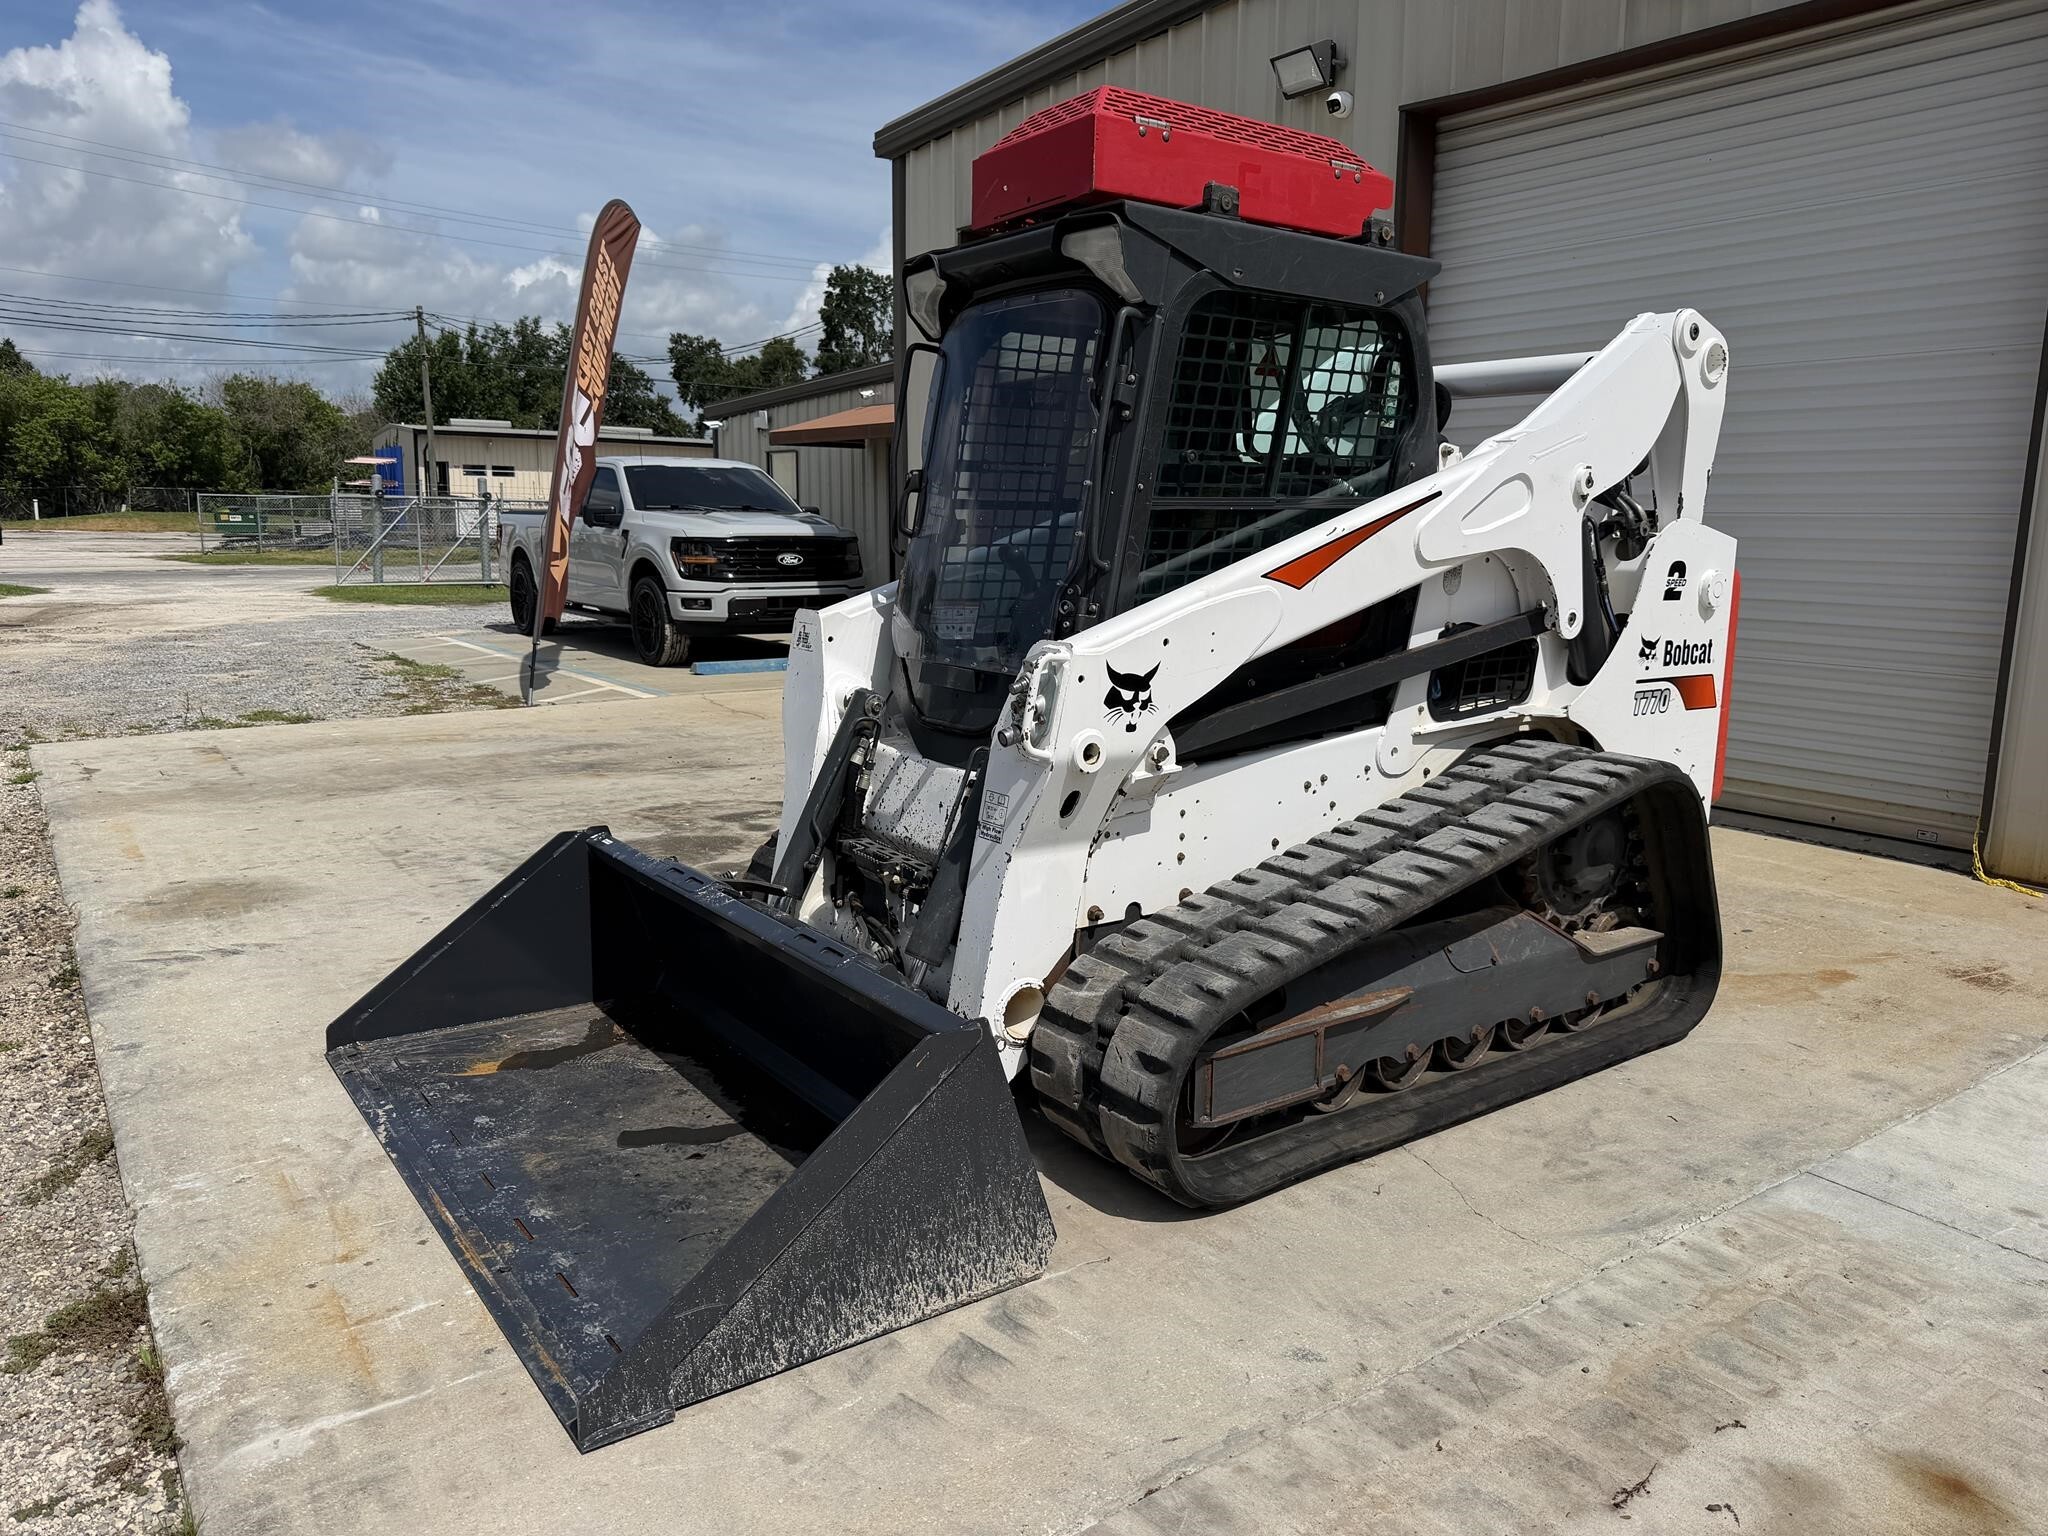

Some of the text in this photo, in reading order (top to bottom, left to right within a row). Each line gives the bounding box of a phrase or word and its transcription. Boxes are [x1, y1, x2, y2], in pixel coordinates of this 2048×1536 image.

[577, 239, 612, 393] EAST COAST
[588, 261, 622, 413] EQUIPMENT
[1663, 560, 1687, 601] 2
[1665, 579, 1687, 587] SPEED
[1663, 639, 1713, 667] Bobcat
[1633, 688, 1671, 716] T770
